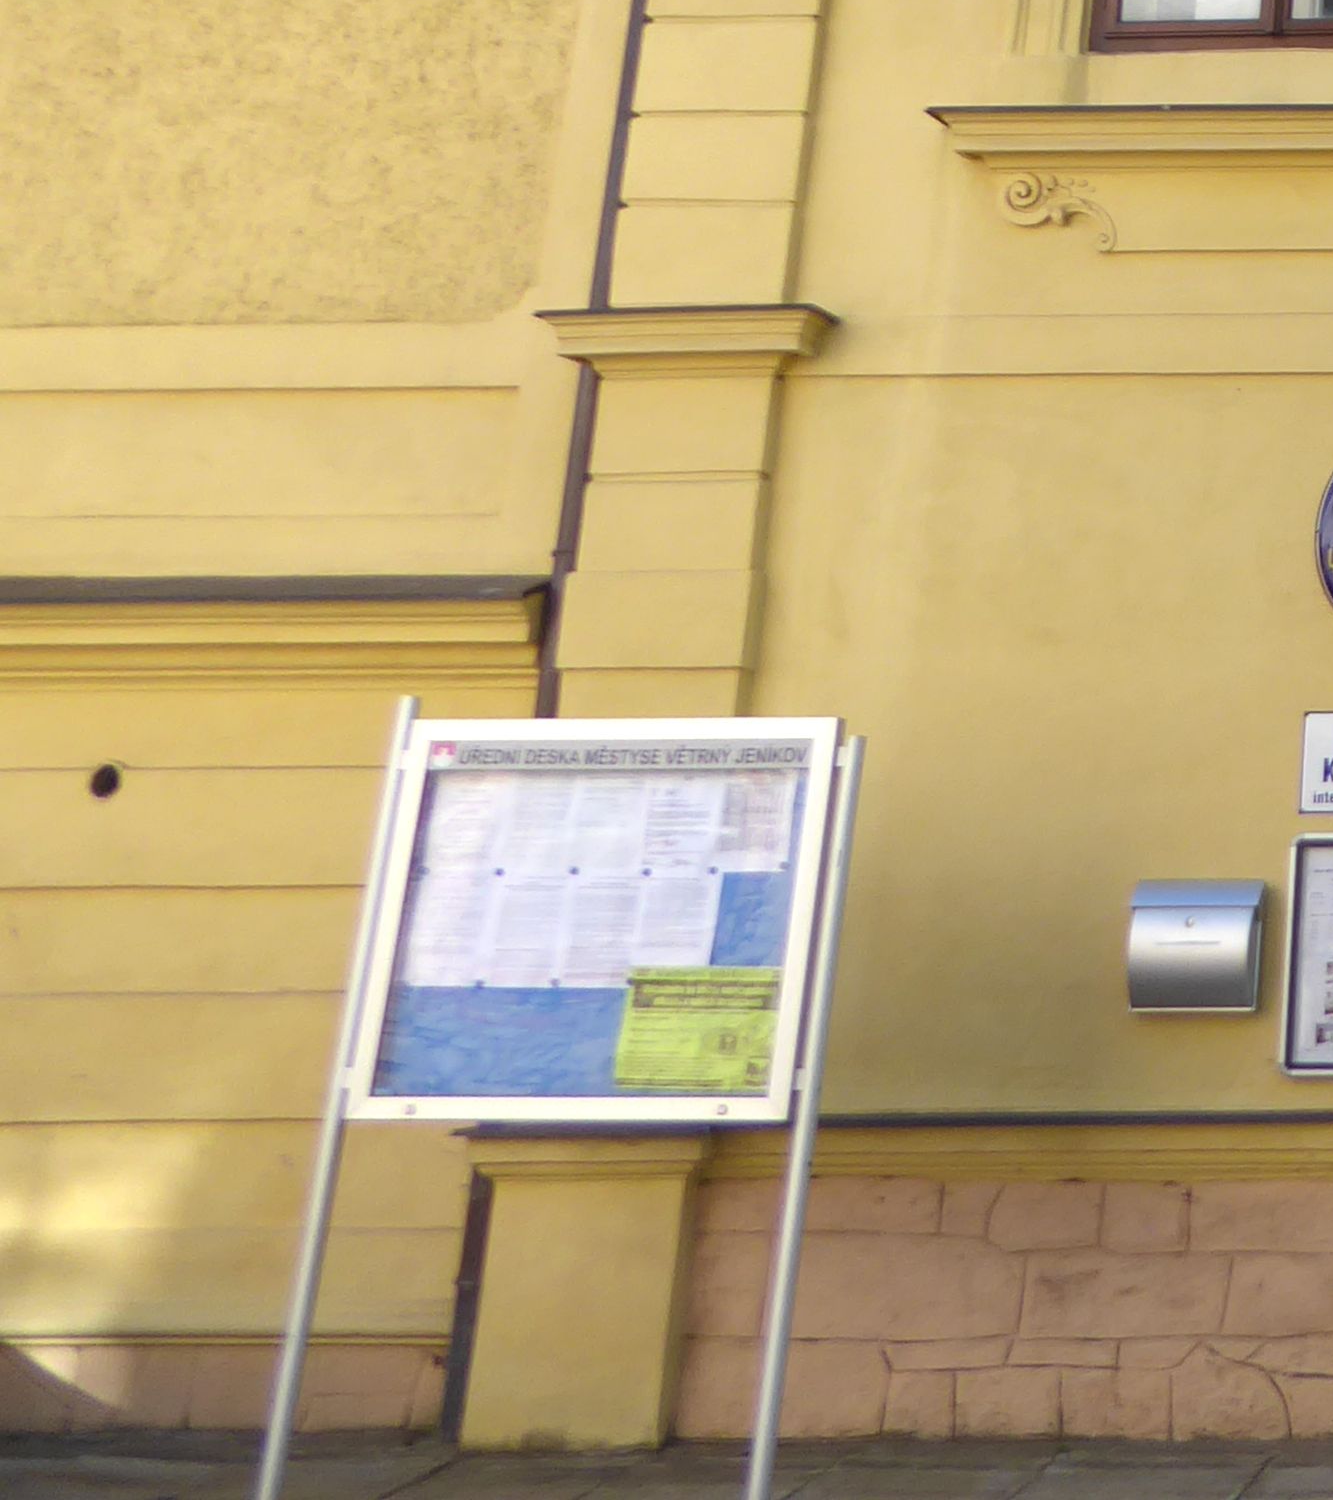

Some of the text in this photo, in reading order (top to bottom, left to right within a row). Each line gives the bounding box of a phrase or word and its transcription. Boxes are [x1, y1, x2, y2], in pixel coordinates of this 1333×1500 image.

[524, 749, 580, 765] DESKA
[584, 745, 660, 765] MĚSTYSE
[665, 744, 732, 765] VĚTRNÝ
[735, 743, 808, 764] JENÍKOV
